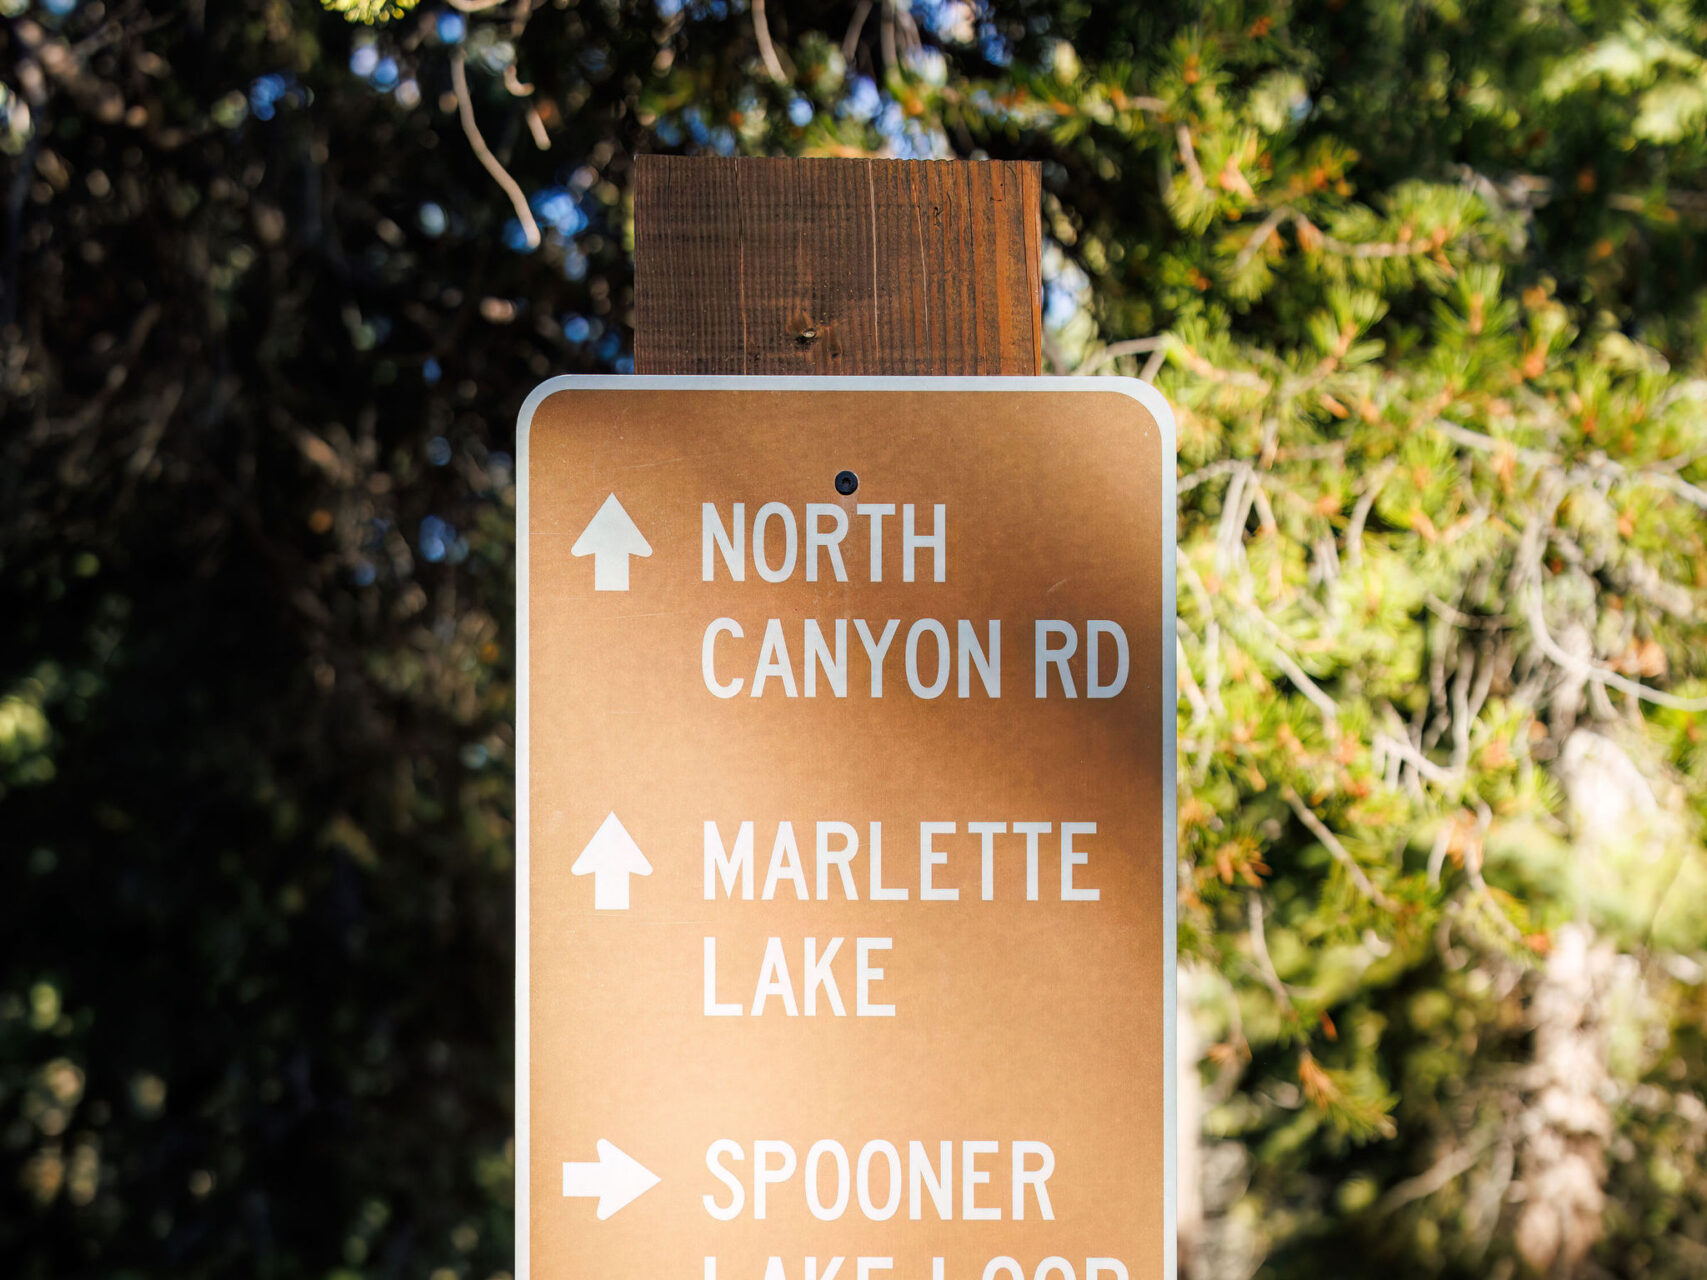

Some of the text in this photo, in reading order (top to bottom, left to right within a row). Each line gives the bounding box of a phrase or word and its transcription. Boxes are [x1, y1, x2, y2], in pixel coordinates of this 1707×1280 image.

[701, 502, 947, 583] NORTH
[701, 617, 1131, 699] CANYON RD
[702, 820, 1102, 901] MARLETTE
[702, 936, 897, 1017] LAKE
[702, 1138, 1057, 1221] SPOONER
